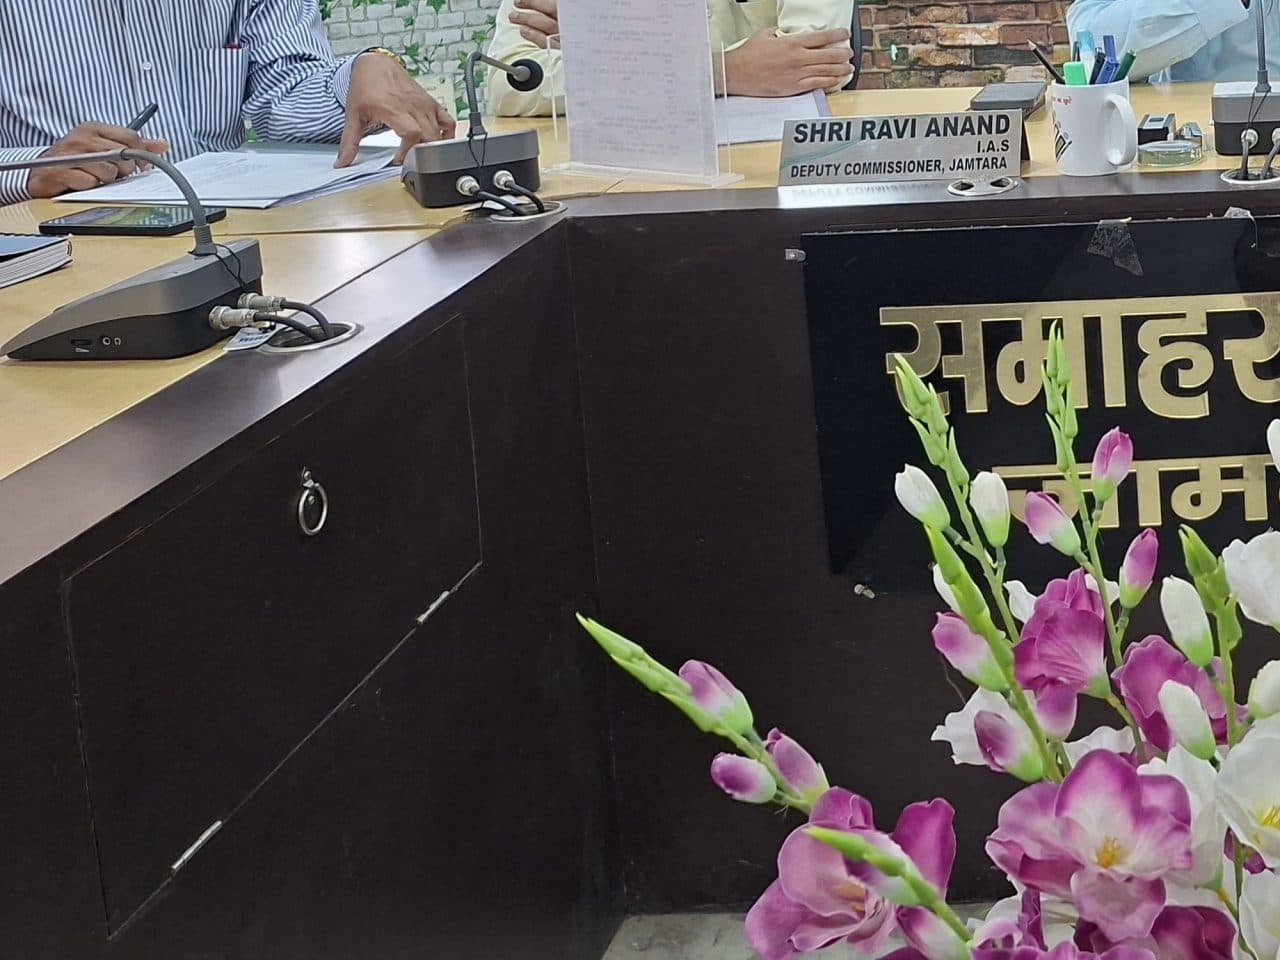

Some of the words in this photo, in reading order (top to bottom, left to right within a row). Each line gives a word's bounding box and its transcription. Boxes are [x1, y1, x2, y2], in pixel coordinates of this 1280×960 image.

[793, 120, 852, 144] SHRI
[860, 118, 917, 141] RAVI
[924, 113, 1011, 138] ANAND
[976, 139, 1010, 153] I.A.S
[790, 162, 842, 178] DEPUTY
[843, 158, 946, 177] COMMISSIONER,
[949, 156, 1008, 172] JAMTARA
